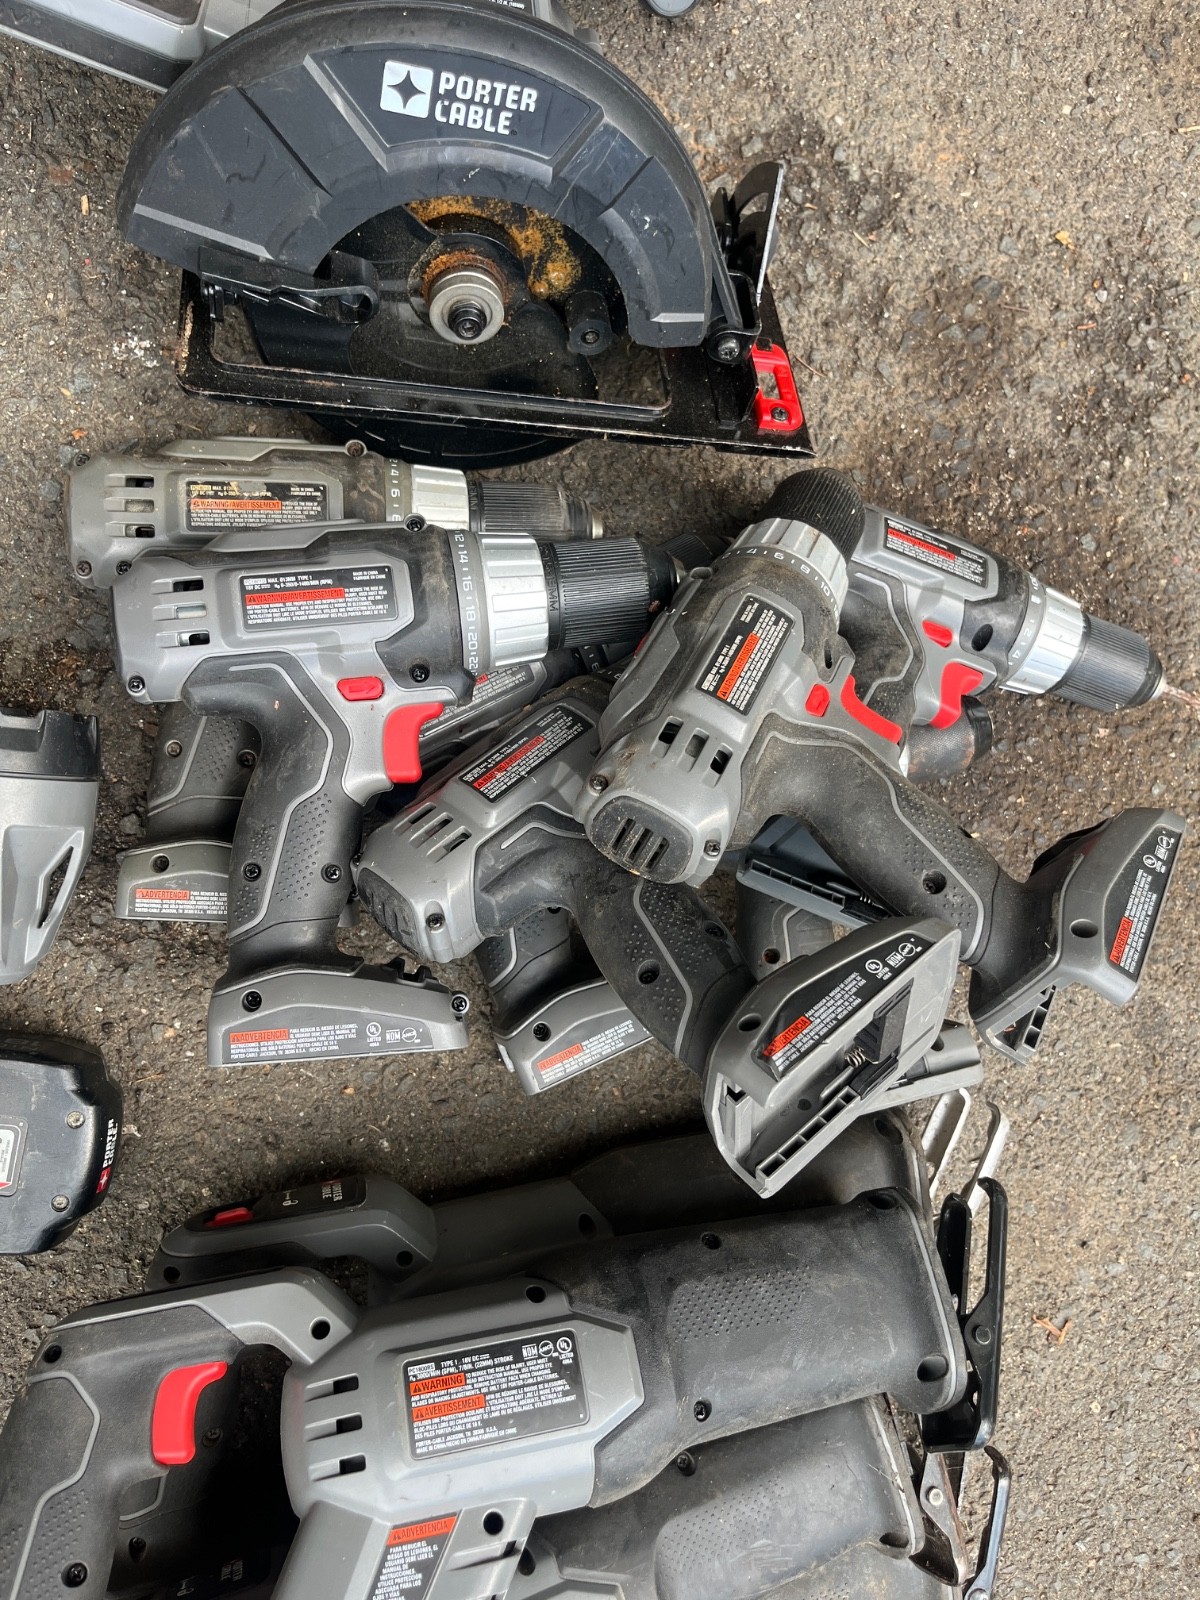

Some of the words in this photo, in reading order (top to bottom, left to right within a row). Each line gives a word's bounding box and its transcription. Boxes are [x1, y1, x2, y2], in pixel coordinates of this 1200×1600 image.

[439, 72, 538, 112] PORTER
[435, 99, 513, 135] CABLE
[454, 534, 464, 542] 12
[458, 551, 468, 563] 14
[462, 576, 473, 591] 16
[820, 581, 830, 596] 10
[256, 587, 342, 603] WARNING/AVERTISSEMENT
[466, 605, 476, 621] 18
[468, 633, 478, 650] 20
[144, 890, 187, 898] ADVERTENCIA
[868, 961, 879, 972] UL
[887, 952, 903, 967] NOM
[240, 1029, 288, 1042] ADVERTENCIA
[369, 1025, 377, 1033] UL
[385, 1031, 400, 1040] NOM
[103, 1118, 114, 1168] PORTER
[521, 1345, 538, 1357] NOM
[559, 1339, 568, 1350] UL
[440, 1359, 453, 1367] TYPE
[474, 1358, 493, 1368] (22MM)
[493, 1354, 513, 1364] STROKE
[421, 1374, 463, 1391] WARNING
[423, 1396, 481, 1417] AVERTISSEMENT
[400, 1520, 448, 1538] ADVERTENCIA
